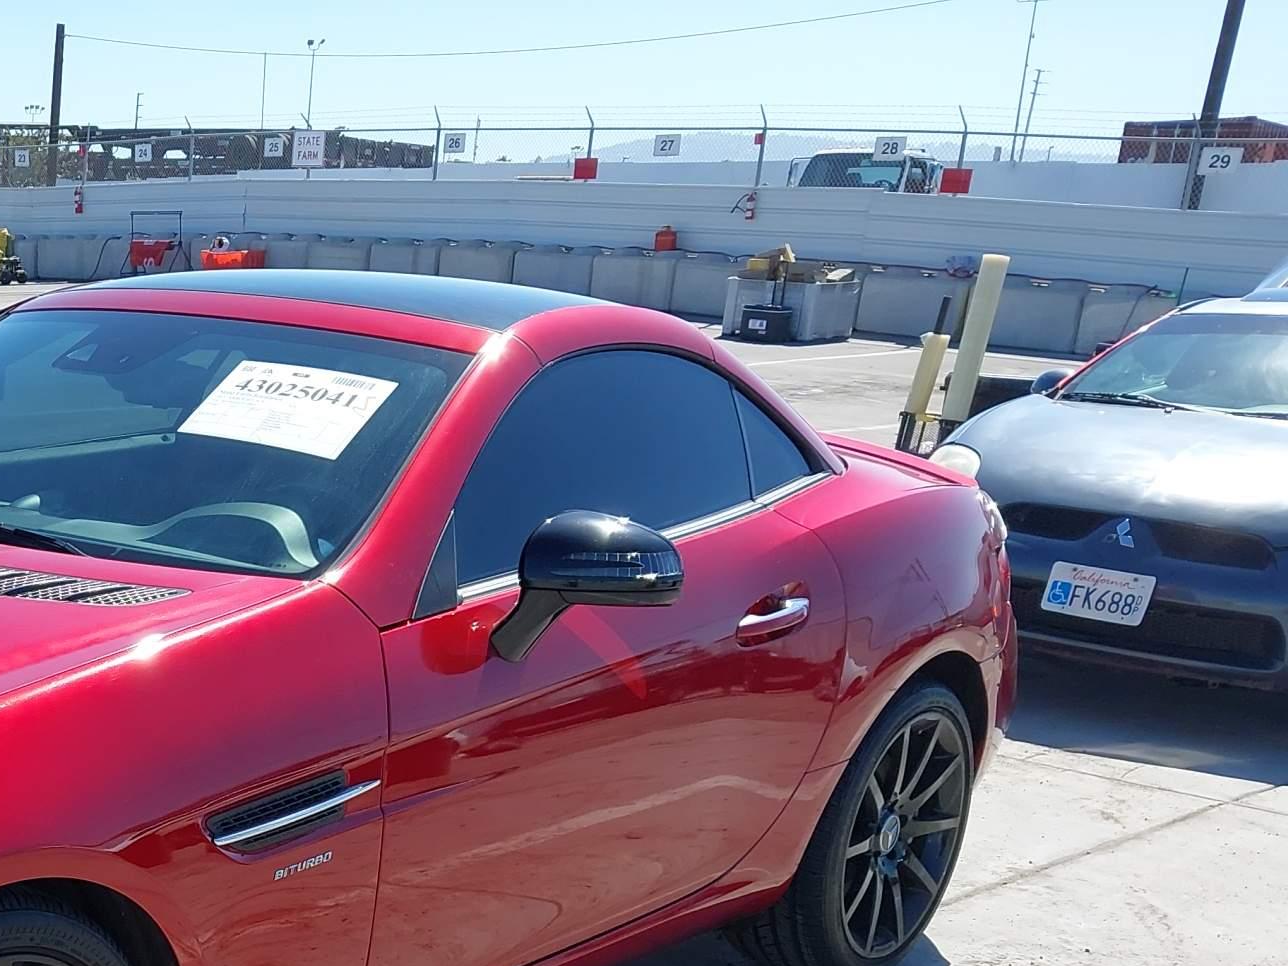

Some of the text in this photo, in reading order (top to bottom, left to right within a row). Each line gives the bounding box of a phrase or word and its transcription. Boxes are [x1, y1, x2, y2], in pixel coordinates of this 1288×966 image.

[268, 142, 279, 152] 25
[297, 136, 321, 146] STATE
[448, 138, 461, 149] 26
[660, 140, 675, 151] 27
[138, 148, 148, 157] 24
[881, 142, 899, 155] 28
[297, 151, 319, 160] FARM
[1209, 154, 1231, 169] 29
[234, 377, 358, 408] 43025041
[1073, 569, 1135, 590] California
[1068, 585, 1136, 616] FK688
[273, 851, 333, 881] BITURBO
